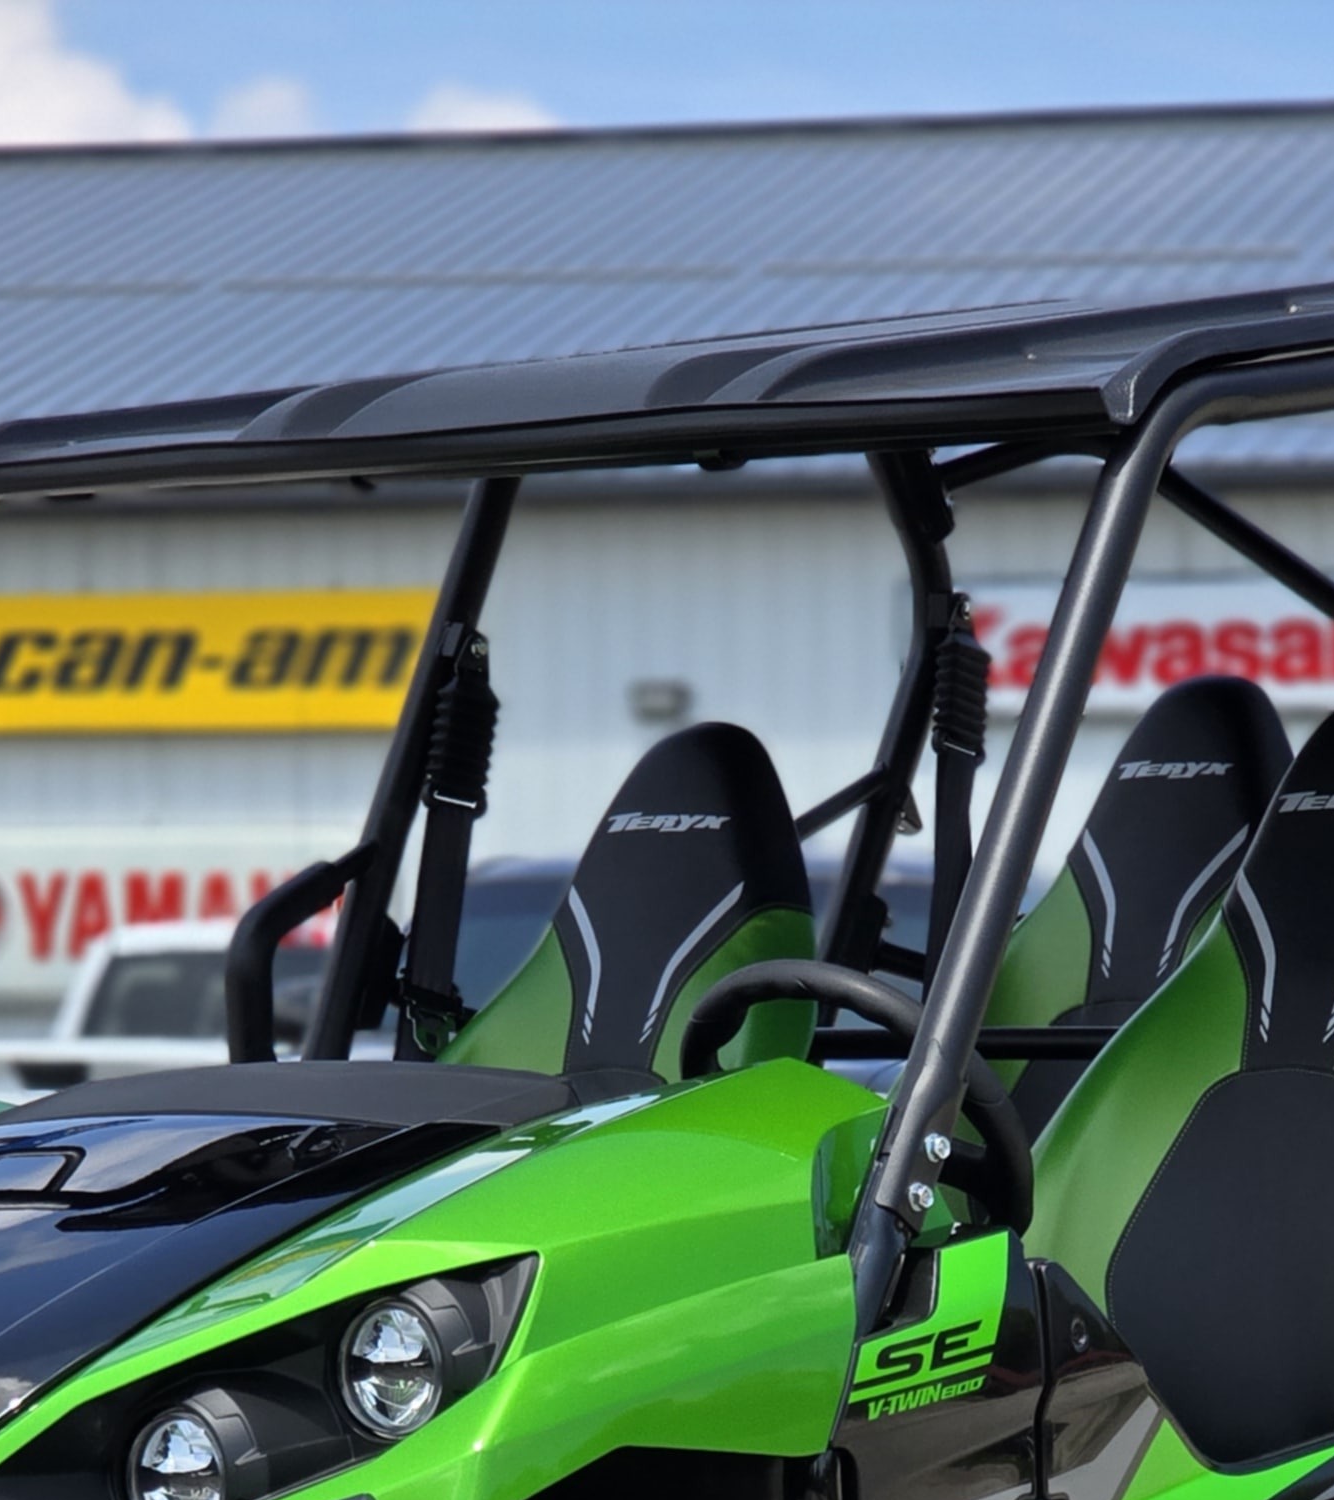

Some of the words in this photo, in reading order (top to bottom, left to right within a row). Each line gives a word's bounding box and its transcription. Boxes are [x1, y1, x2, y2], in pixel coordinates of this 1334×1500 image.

[1118, 760, 1233, 781] TERYX
[607, 812, 731, 834] TERYX
[855, 1319, 996, 1389] SE
